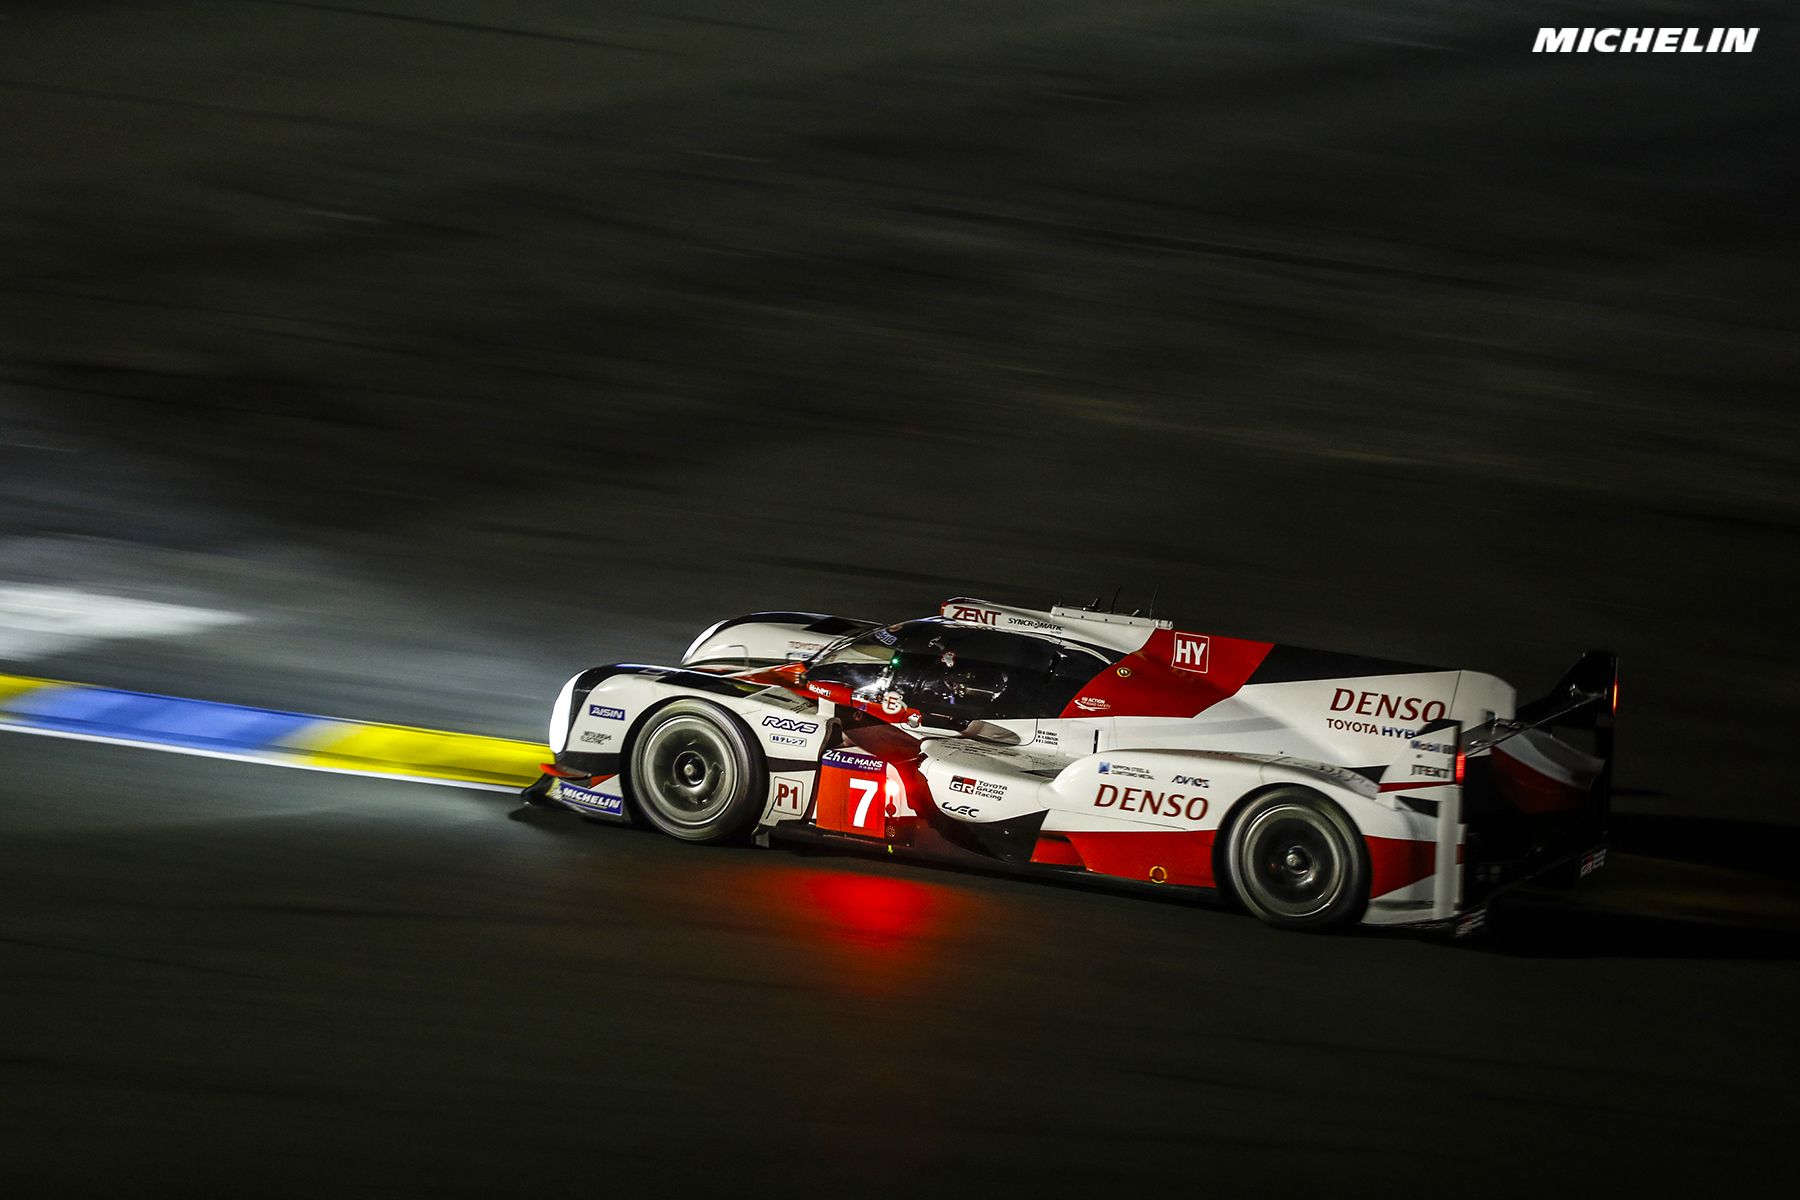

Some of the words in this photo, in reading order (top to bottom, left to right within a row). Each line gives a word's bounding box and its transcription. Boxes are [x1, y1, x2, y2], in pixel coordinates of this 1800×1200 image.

[952, 605, 1002, 626] ZENT
[1175, 639, 1207, 666] HY
[887, 696, 897, 711] E
[1329, 687, 1446, 723] DENSO
[591, 706, 623, 719] AISIN
[762, 715, 819, 734] RAYS
[1326, 718, 1379, 735] TOYOTA
[854, 757, 884, 768] MANS
[1410, 764, 1450, 779] JTEKT
[950, 781, 974, 795] GR
[976, 785, 1004, 795] GAZOO
[978, 780, 1008, 790] TOYOTA
[562, 787, 621, 809] MICHELIN
[776, 783, 798, 810] P1
[849, 778, 879, 828] 7
[975, 790, 1003, 801] Racing
[1093, 783, 1209, 821] DENSO
[941, 801, 980, 818] WEC
